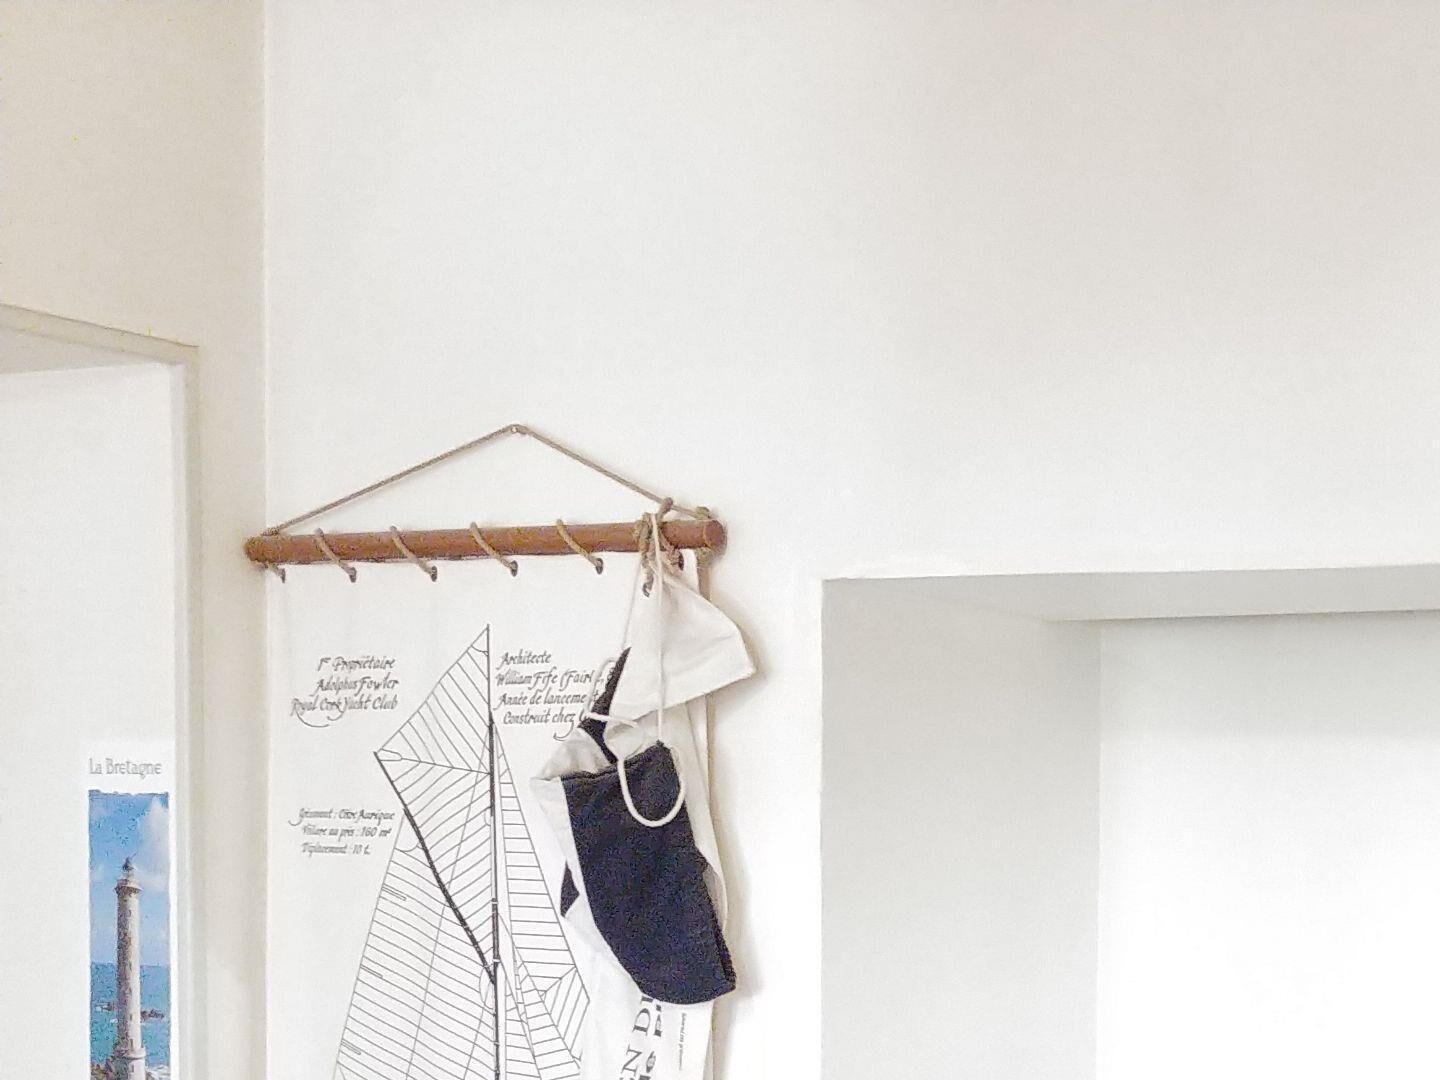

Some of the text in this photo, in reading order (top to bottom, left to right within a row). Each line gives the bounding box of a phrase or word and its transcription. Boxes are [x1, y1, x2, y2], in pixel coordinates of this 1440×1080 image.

[496, 649, 552, 670] Architecte
[354, 672, 399, 697] Fowler
[528, 666, 558, 692] Fife
[372, 694, 399, 710] Club
[529, 688, 543, 705] de
[503, 707, 552, 725] Construit
[552, 706, 576, 735] chez
[105, 757, 162, 780] Bretagne
[361, 826, 377, 837] 160
